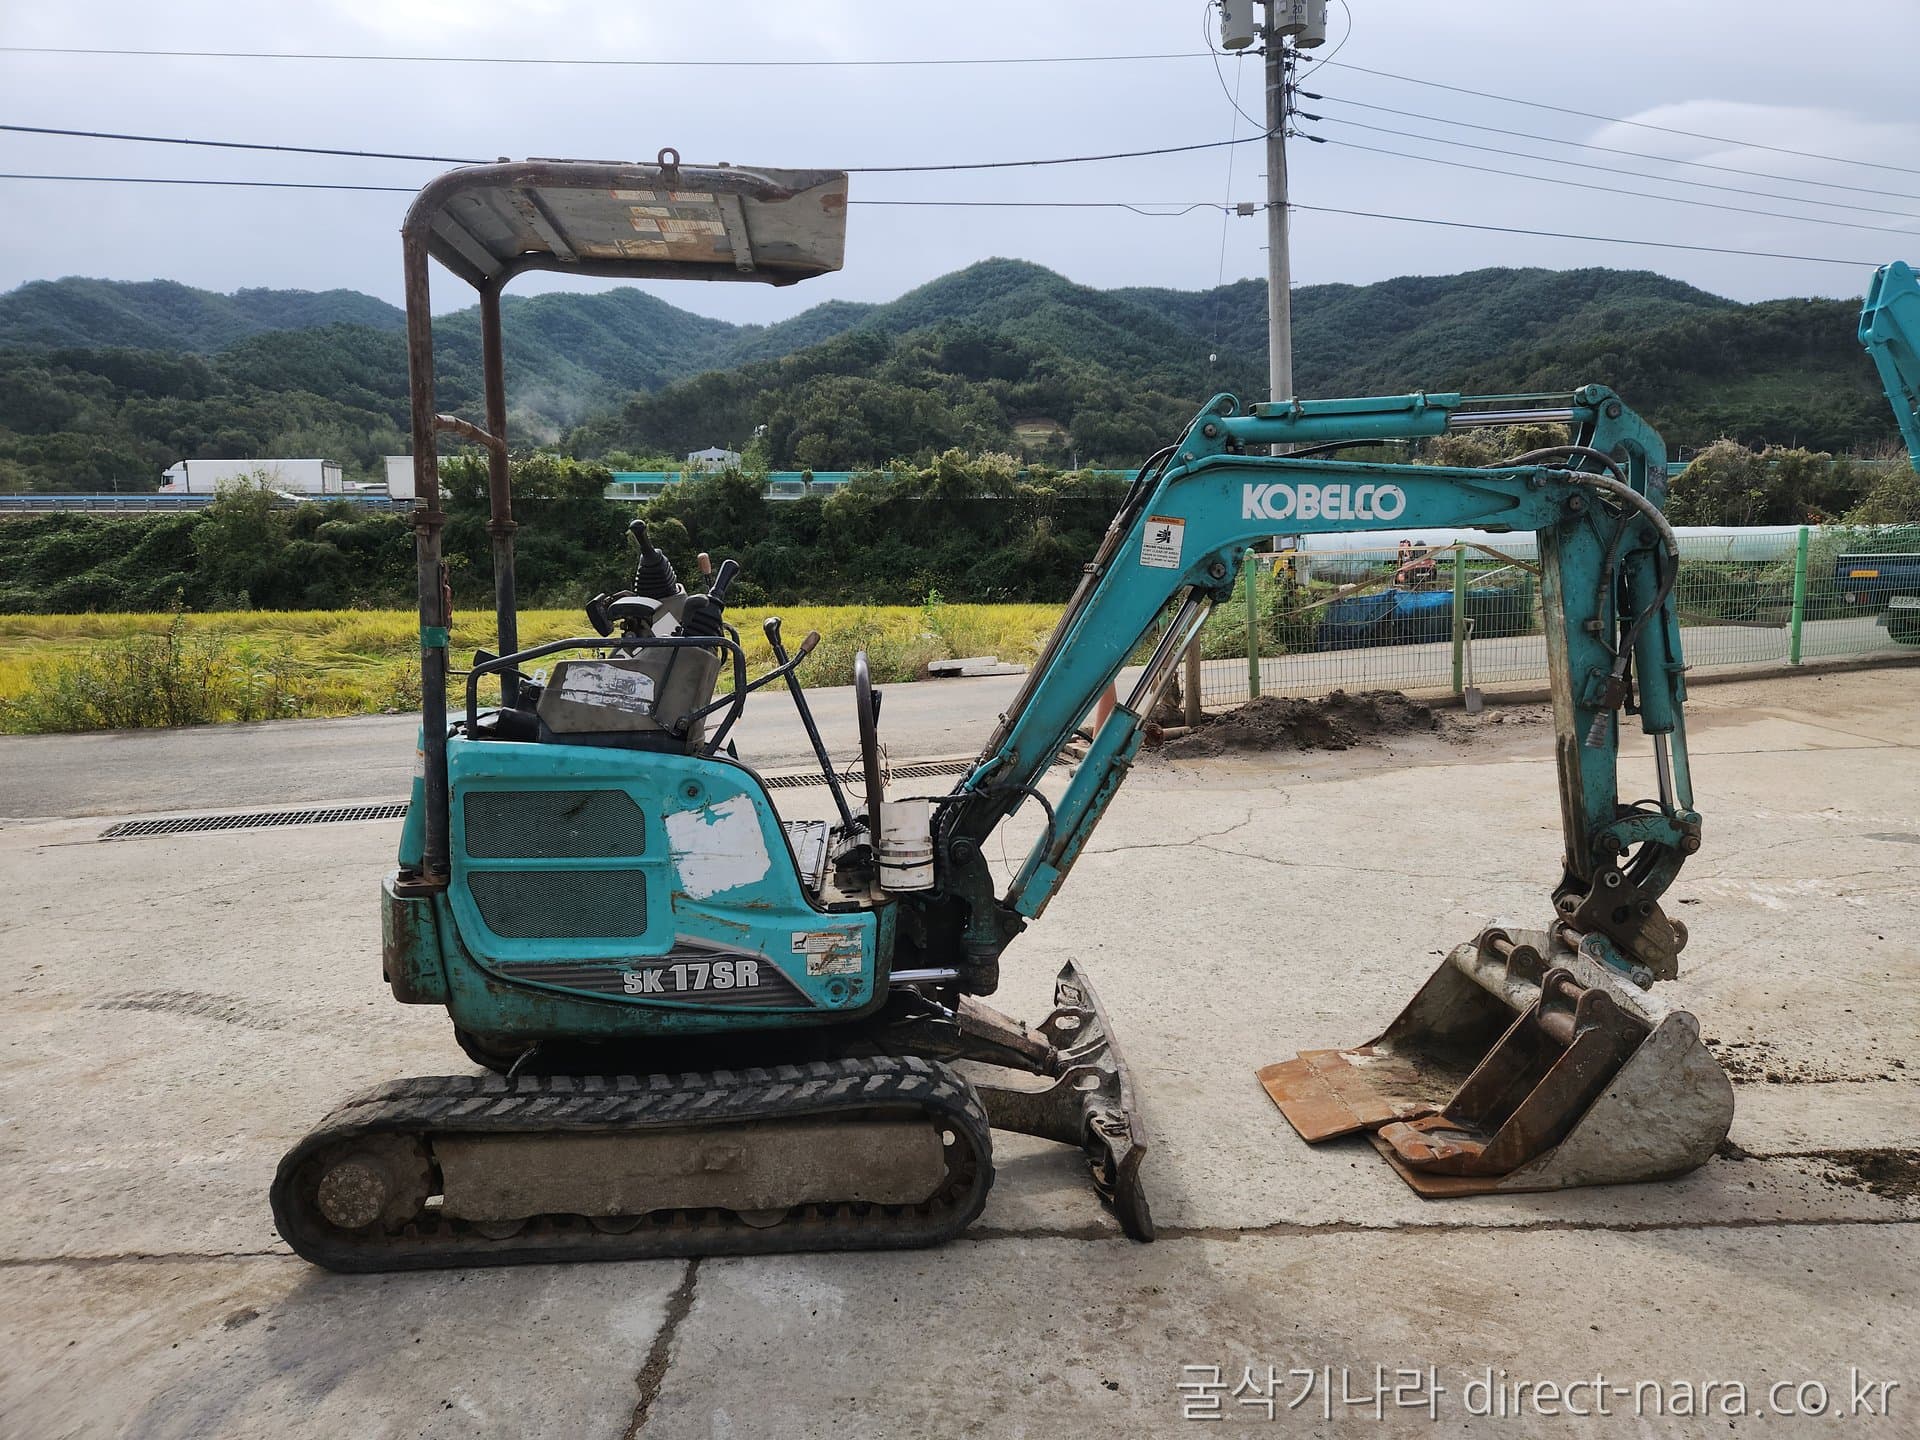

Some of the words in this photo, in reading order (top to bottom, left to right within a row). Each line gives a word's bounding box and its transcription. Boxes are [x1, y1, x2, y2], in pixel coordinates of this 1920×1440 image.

[1242, 483, 1407, 521] KOBELCO
[623, 968, 665, 994] SK
[668, 960, 760, 991] 17SR
